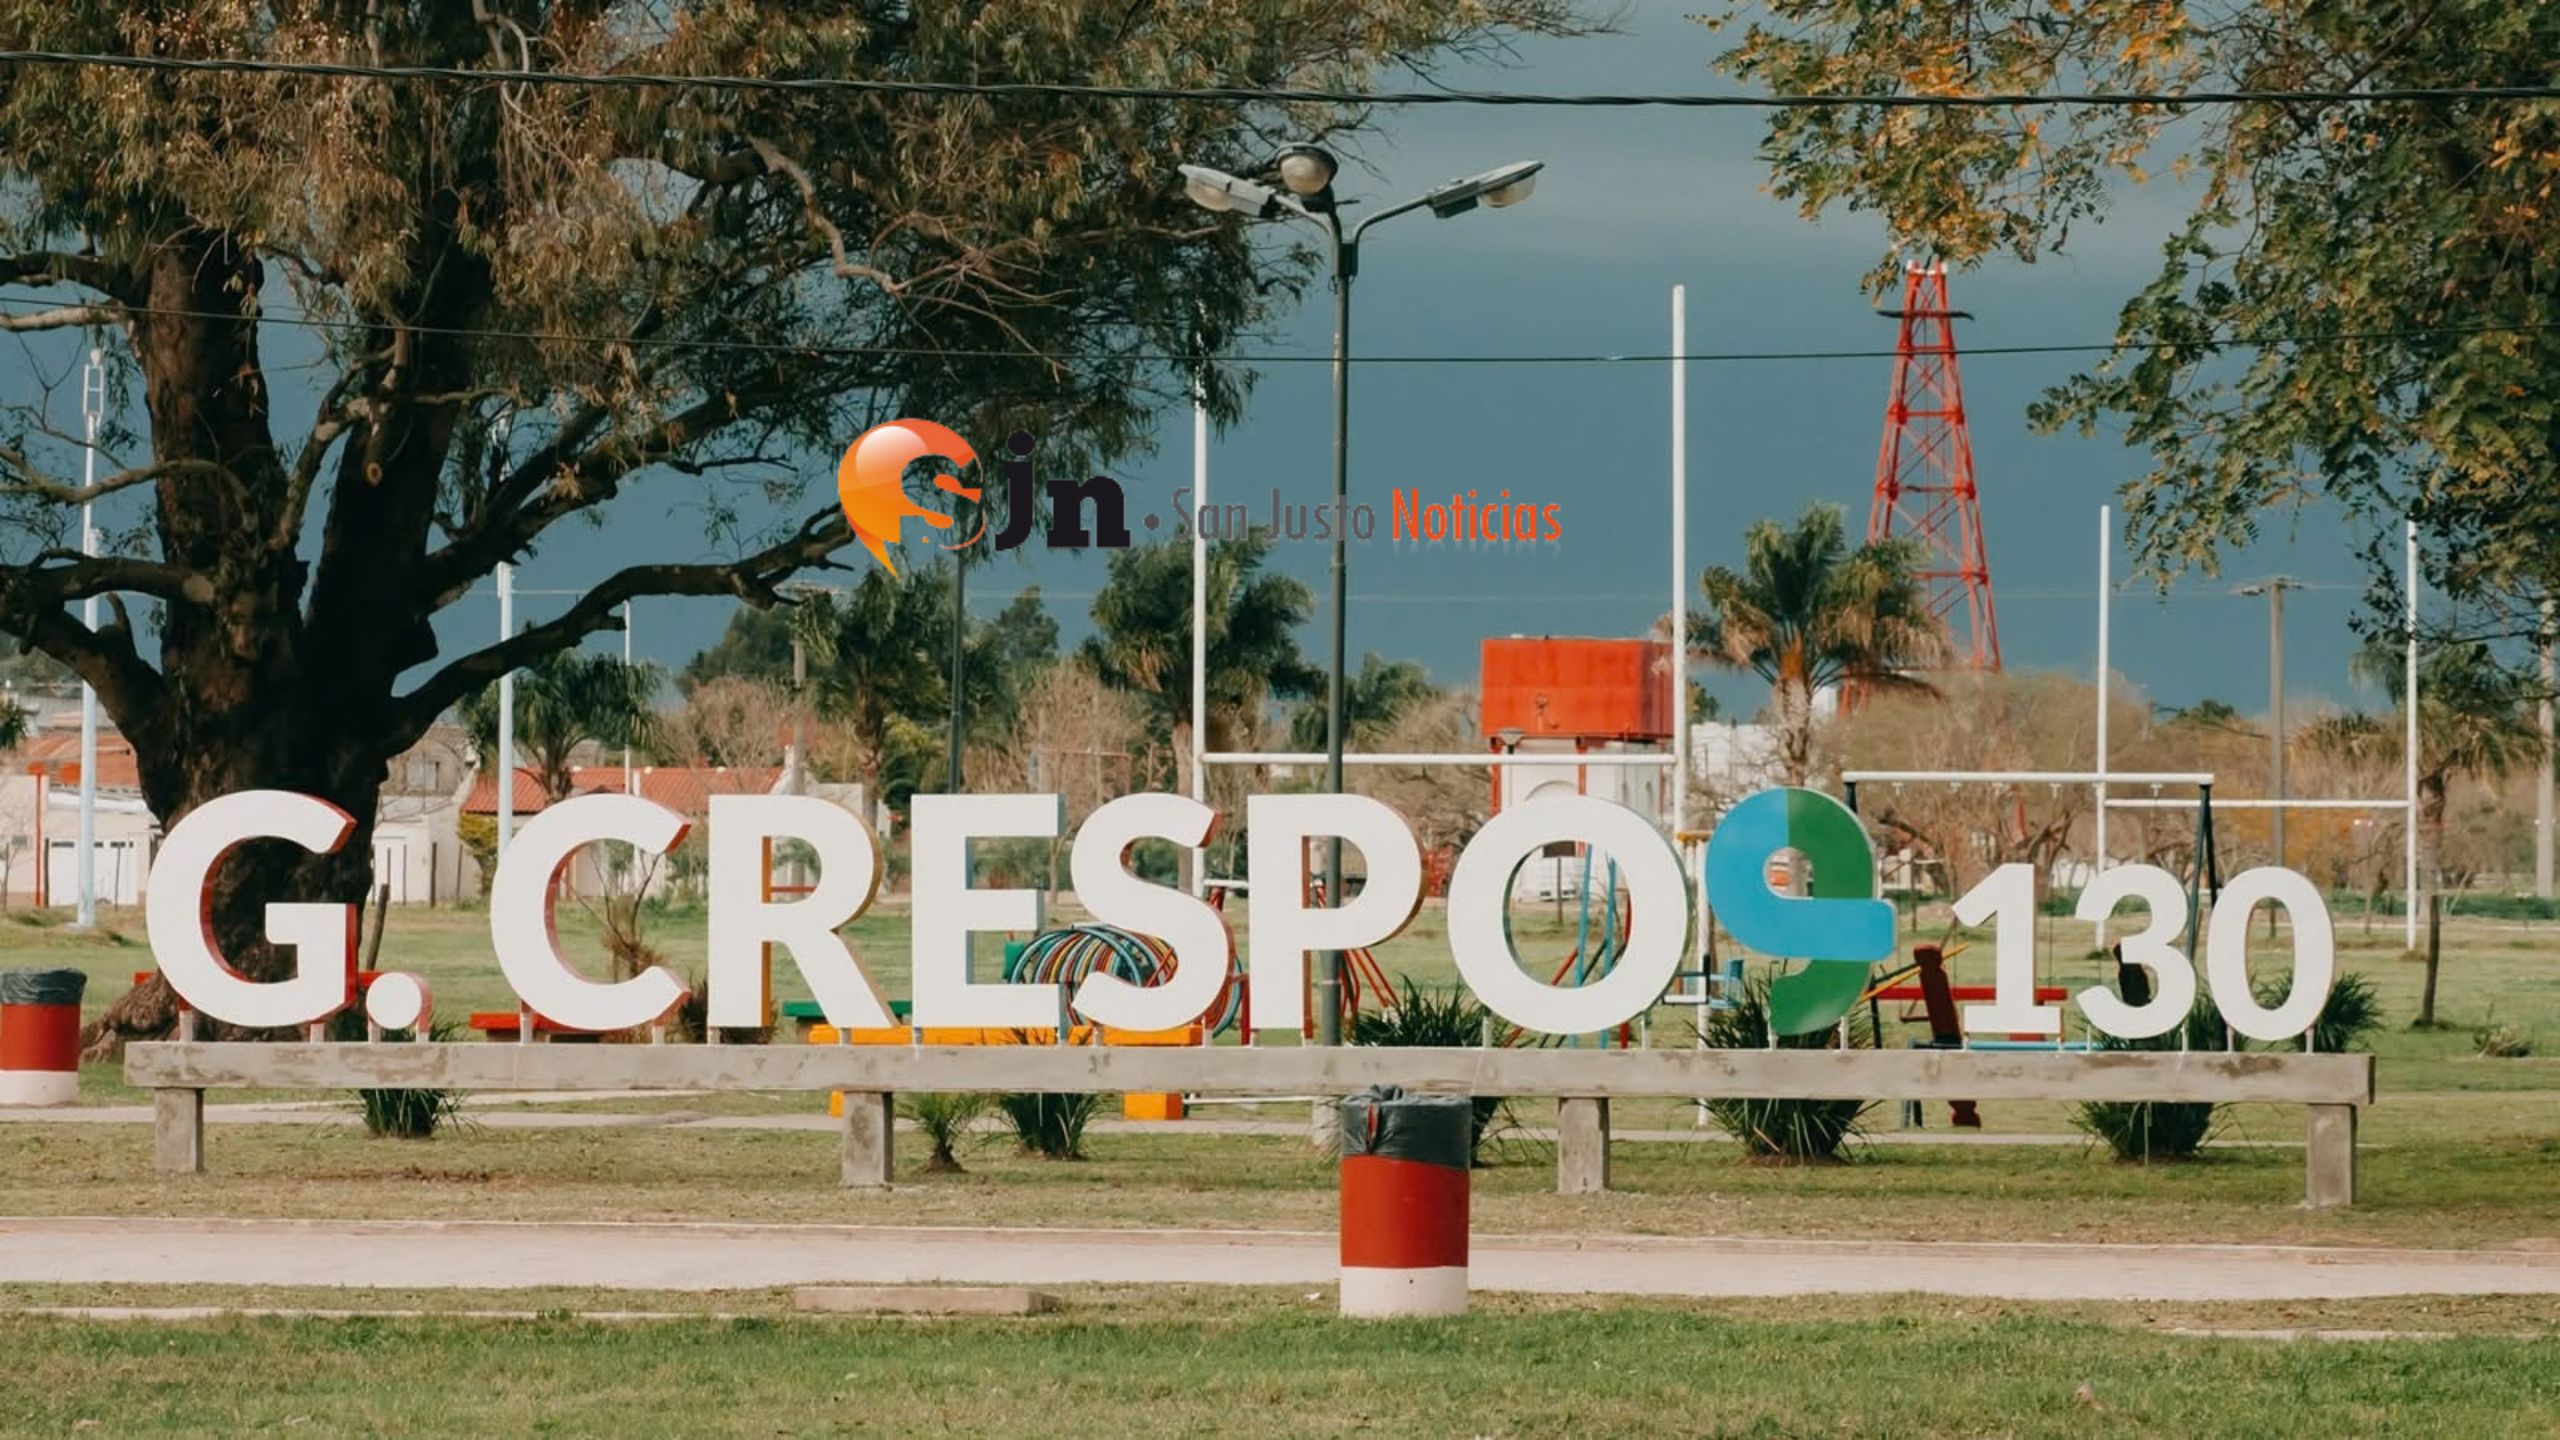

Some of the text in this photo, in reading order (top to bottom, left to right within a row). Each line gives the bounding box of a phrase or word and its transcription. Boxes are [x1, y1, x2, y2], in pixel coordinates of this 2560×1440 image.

[147, 790, 2335, 1041] G. CRESPO 130
